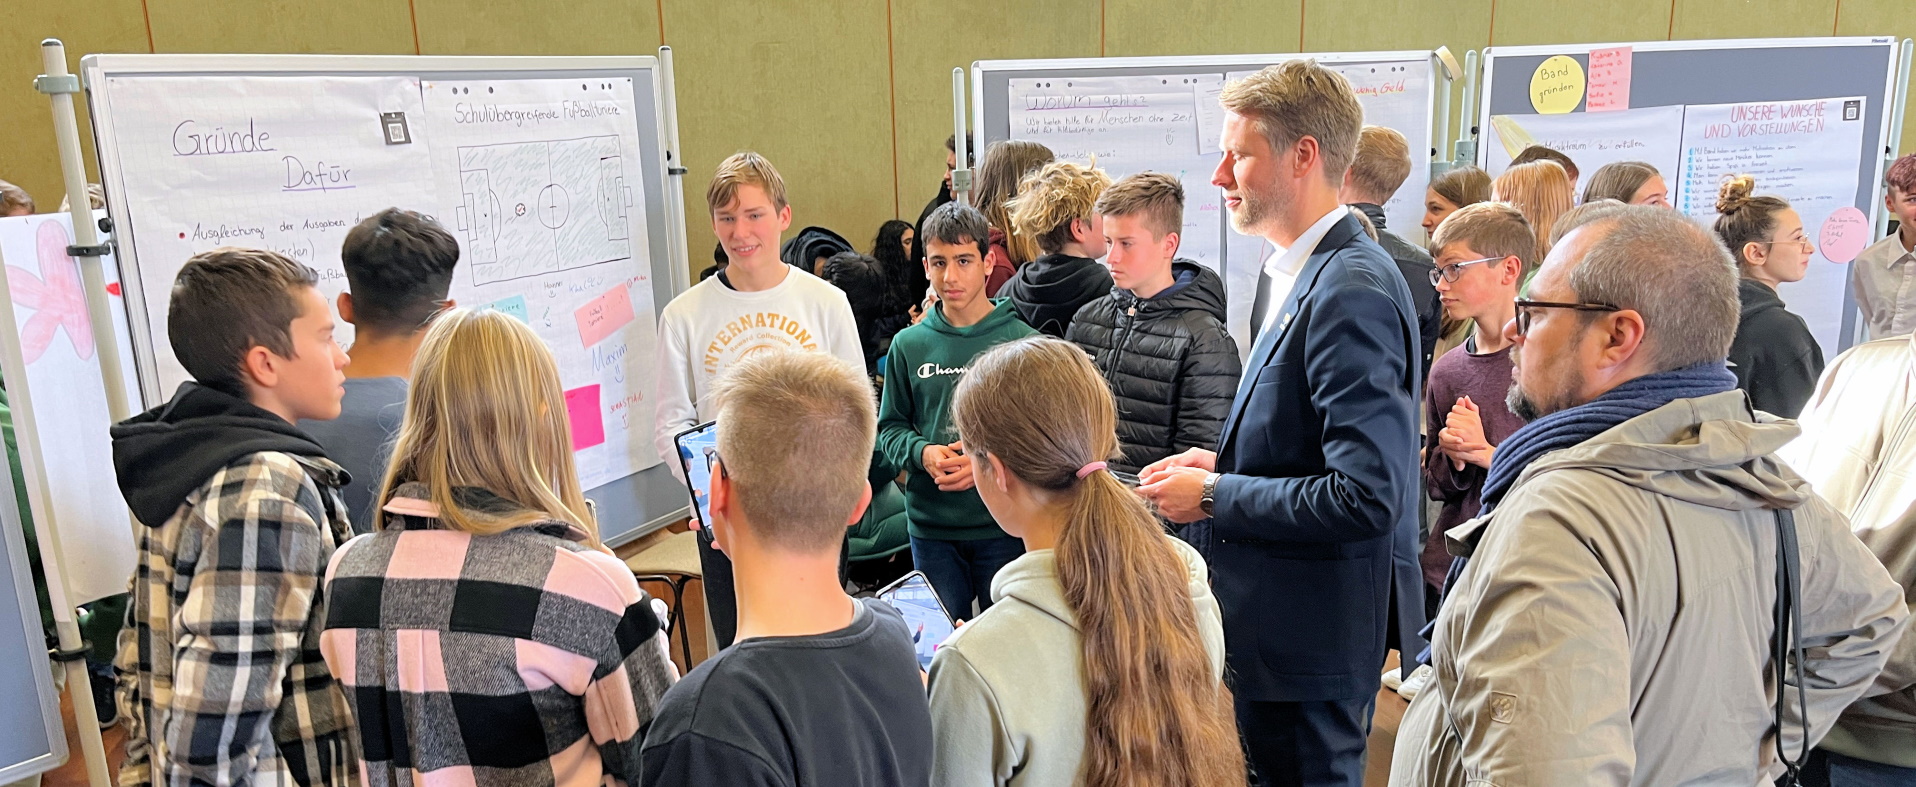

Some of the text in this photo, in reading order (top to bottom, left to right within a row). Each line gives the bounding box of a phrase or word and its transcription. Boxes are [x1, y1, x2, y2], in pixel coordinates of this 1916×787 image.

[1540, 64, 1569, 81] Band
[1354, 78, 1406, 97] wenig Geld.
[1539, 83, 1574, 104] gründen
[1025, 93, 1091, 110] Worum
[455, 102, 559, 127] Schulübergreifende
[1098, 110, 1144, 126] Menschen
[1148, 112, 1164, 123] ohne
[1731, 104, 1777, 124] UNSERE
[172, 116, 275, 156] Gründe
[1704, 118, 1825, 139] UND VORSTELLUNGEN
[281, 156, 352, 193] Dafür
[279, 221, 295, 233] der
[302, 217, 347, 233] Ausgaben
[704, 312, 817, 375] INTERNATIONA
[756, 333, 792, 347] Collection
[591, 343, 628, 377] Maxim
[917, 363, 970, 379] Cham
